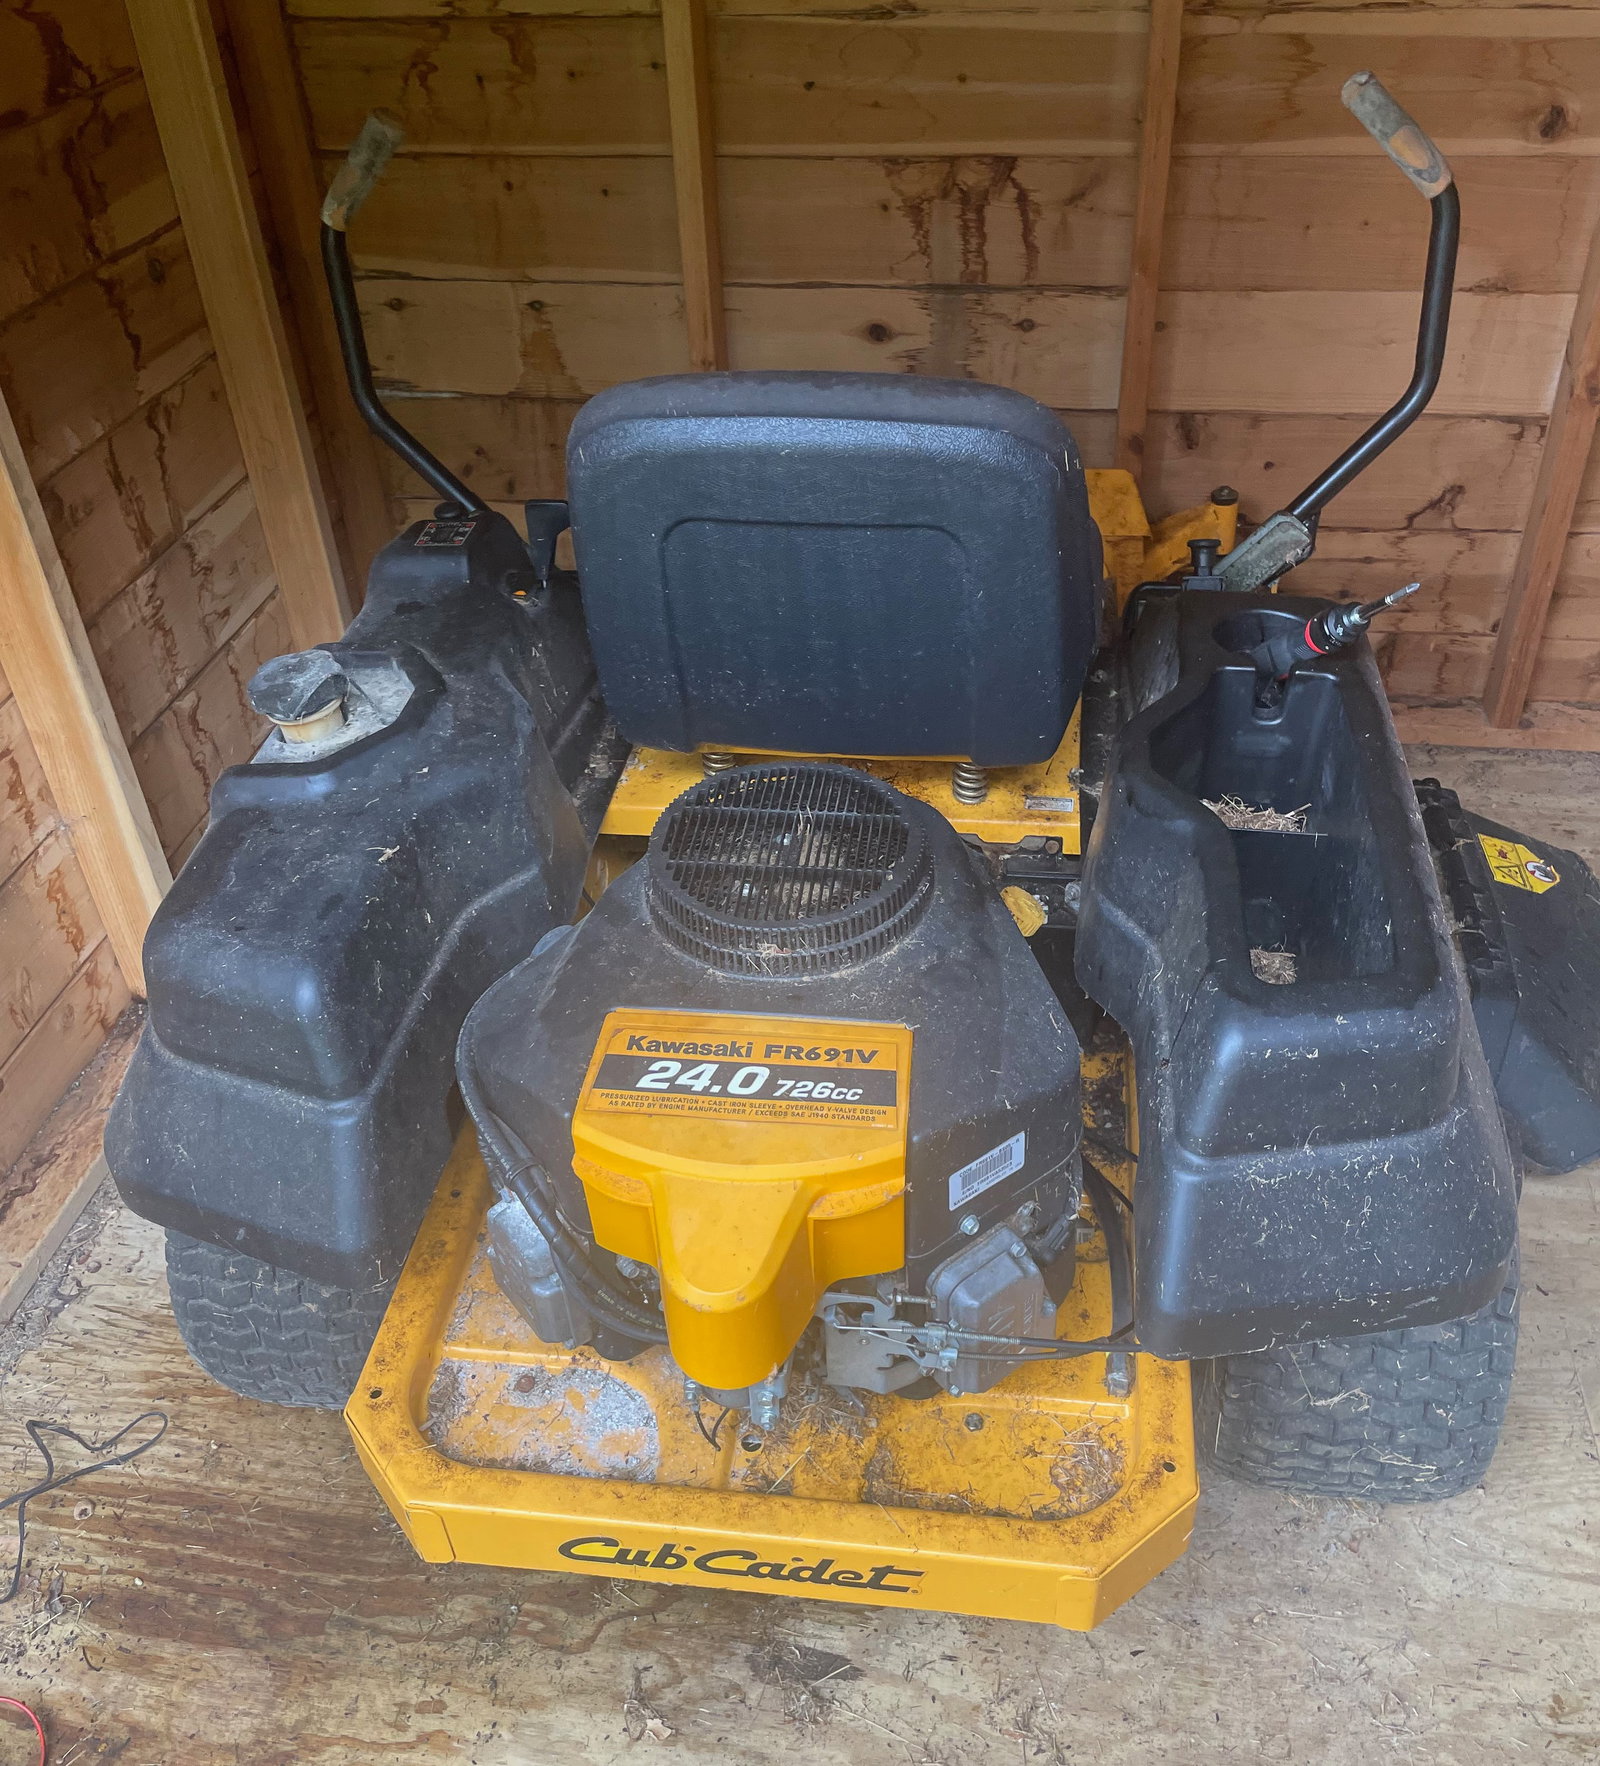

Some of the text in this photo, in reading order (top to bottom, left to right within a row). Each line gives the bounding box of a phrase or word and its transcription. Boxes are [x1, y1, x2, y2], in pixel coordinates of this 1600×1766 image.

[626, 1034, 879, 1064] Kawasaki FR691V
[635, 1060, 864, 1101] 24.0 726cc
[600, 1092, 650, 1101] PRESSURIZED
[652, 1096, 700, 1105] LUBRICATION
[749, 1102, 777, 1110] SLEEVE
[785, 1104, 825, 1112] OVERHEAD
[827, 1106, 857, 1114] V-VALVE
[860, 1108, 887, 1116] DESIGN
[659, 1103, 685, 1111] ENGINE
[687, 1105, 746, 1114] MANUFACTURER
[754, 1109, 788, 1117] EXCEEDS
[831, 1113, 876, 1122] STANDARDS
[557, 1535, 925, 1593] Cub Cadet
